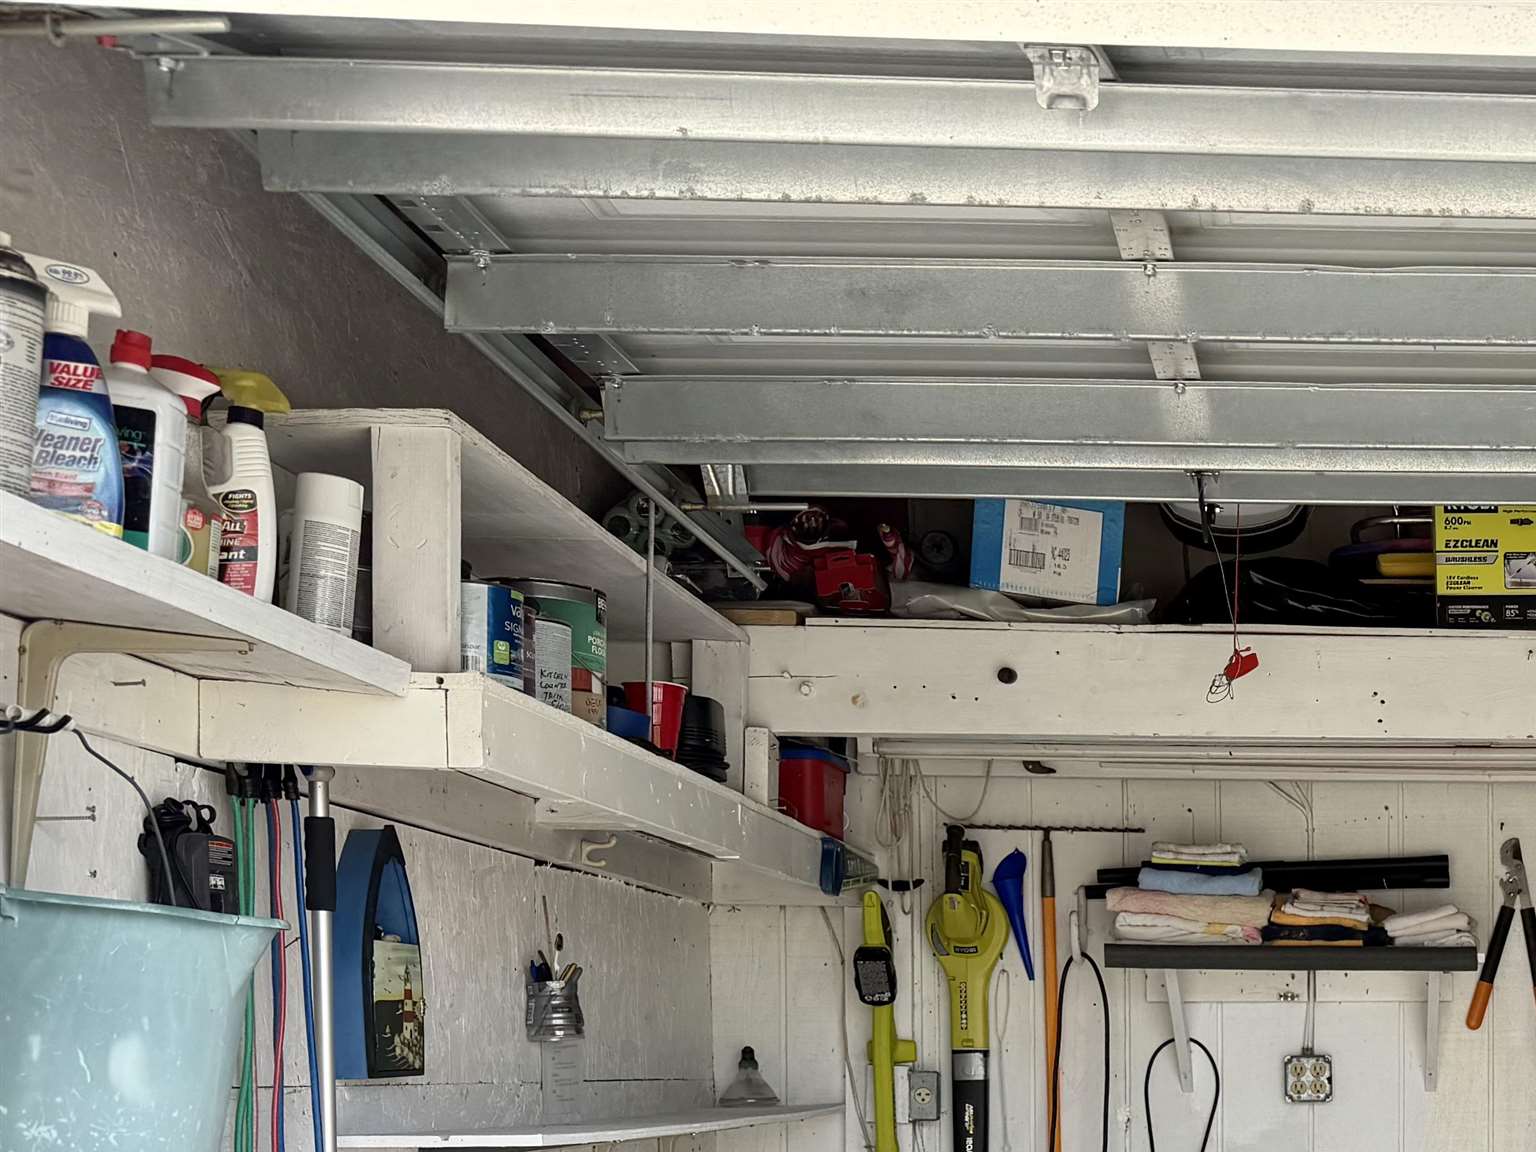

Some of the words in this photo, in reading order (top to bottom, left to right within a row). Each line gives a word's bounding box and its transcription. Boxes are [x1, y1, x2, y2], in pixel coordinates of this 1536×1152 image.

[49, 362, 103, 379] VALUE
[50, 375, 95, 391] SIZE
[35, 429, 104, 453] leaner
[34, 450, 99, 470] Bleach
[1444, 517, 1463, 525] 600
[1445, 539, 1498, 549] EZCLEAN
